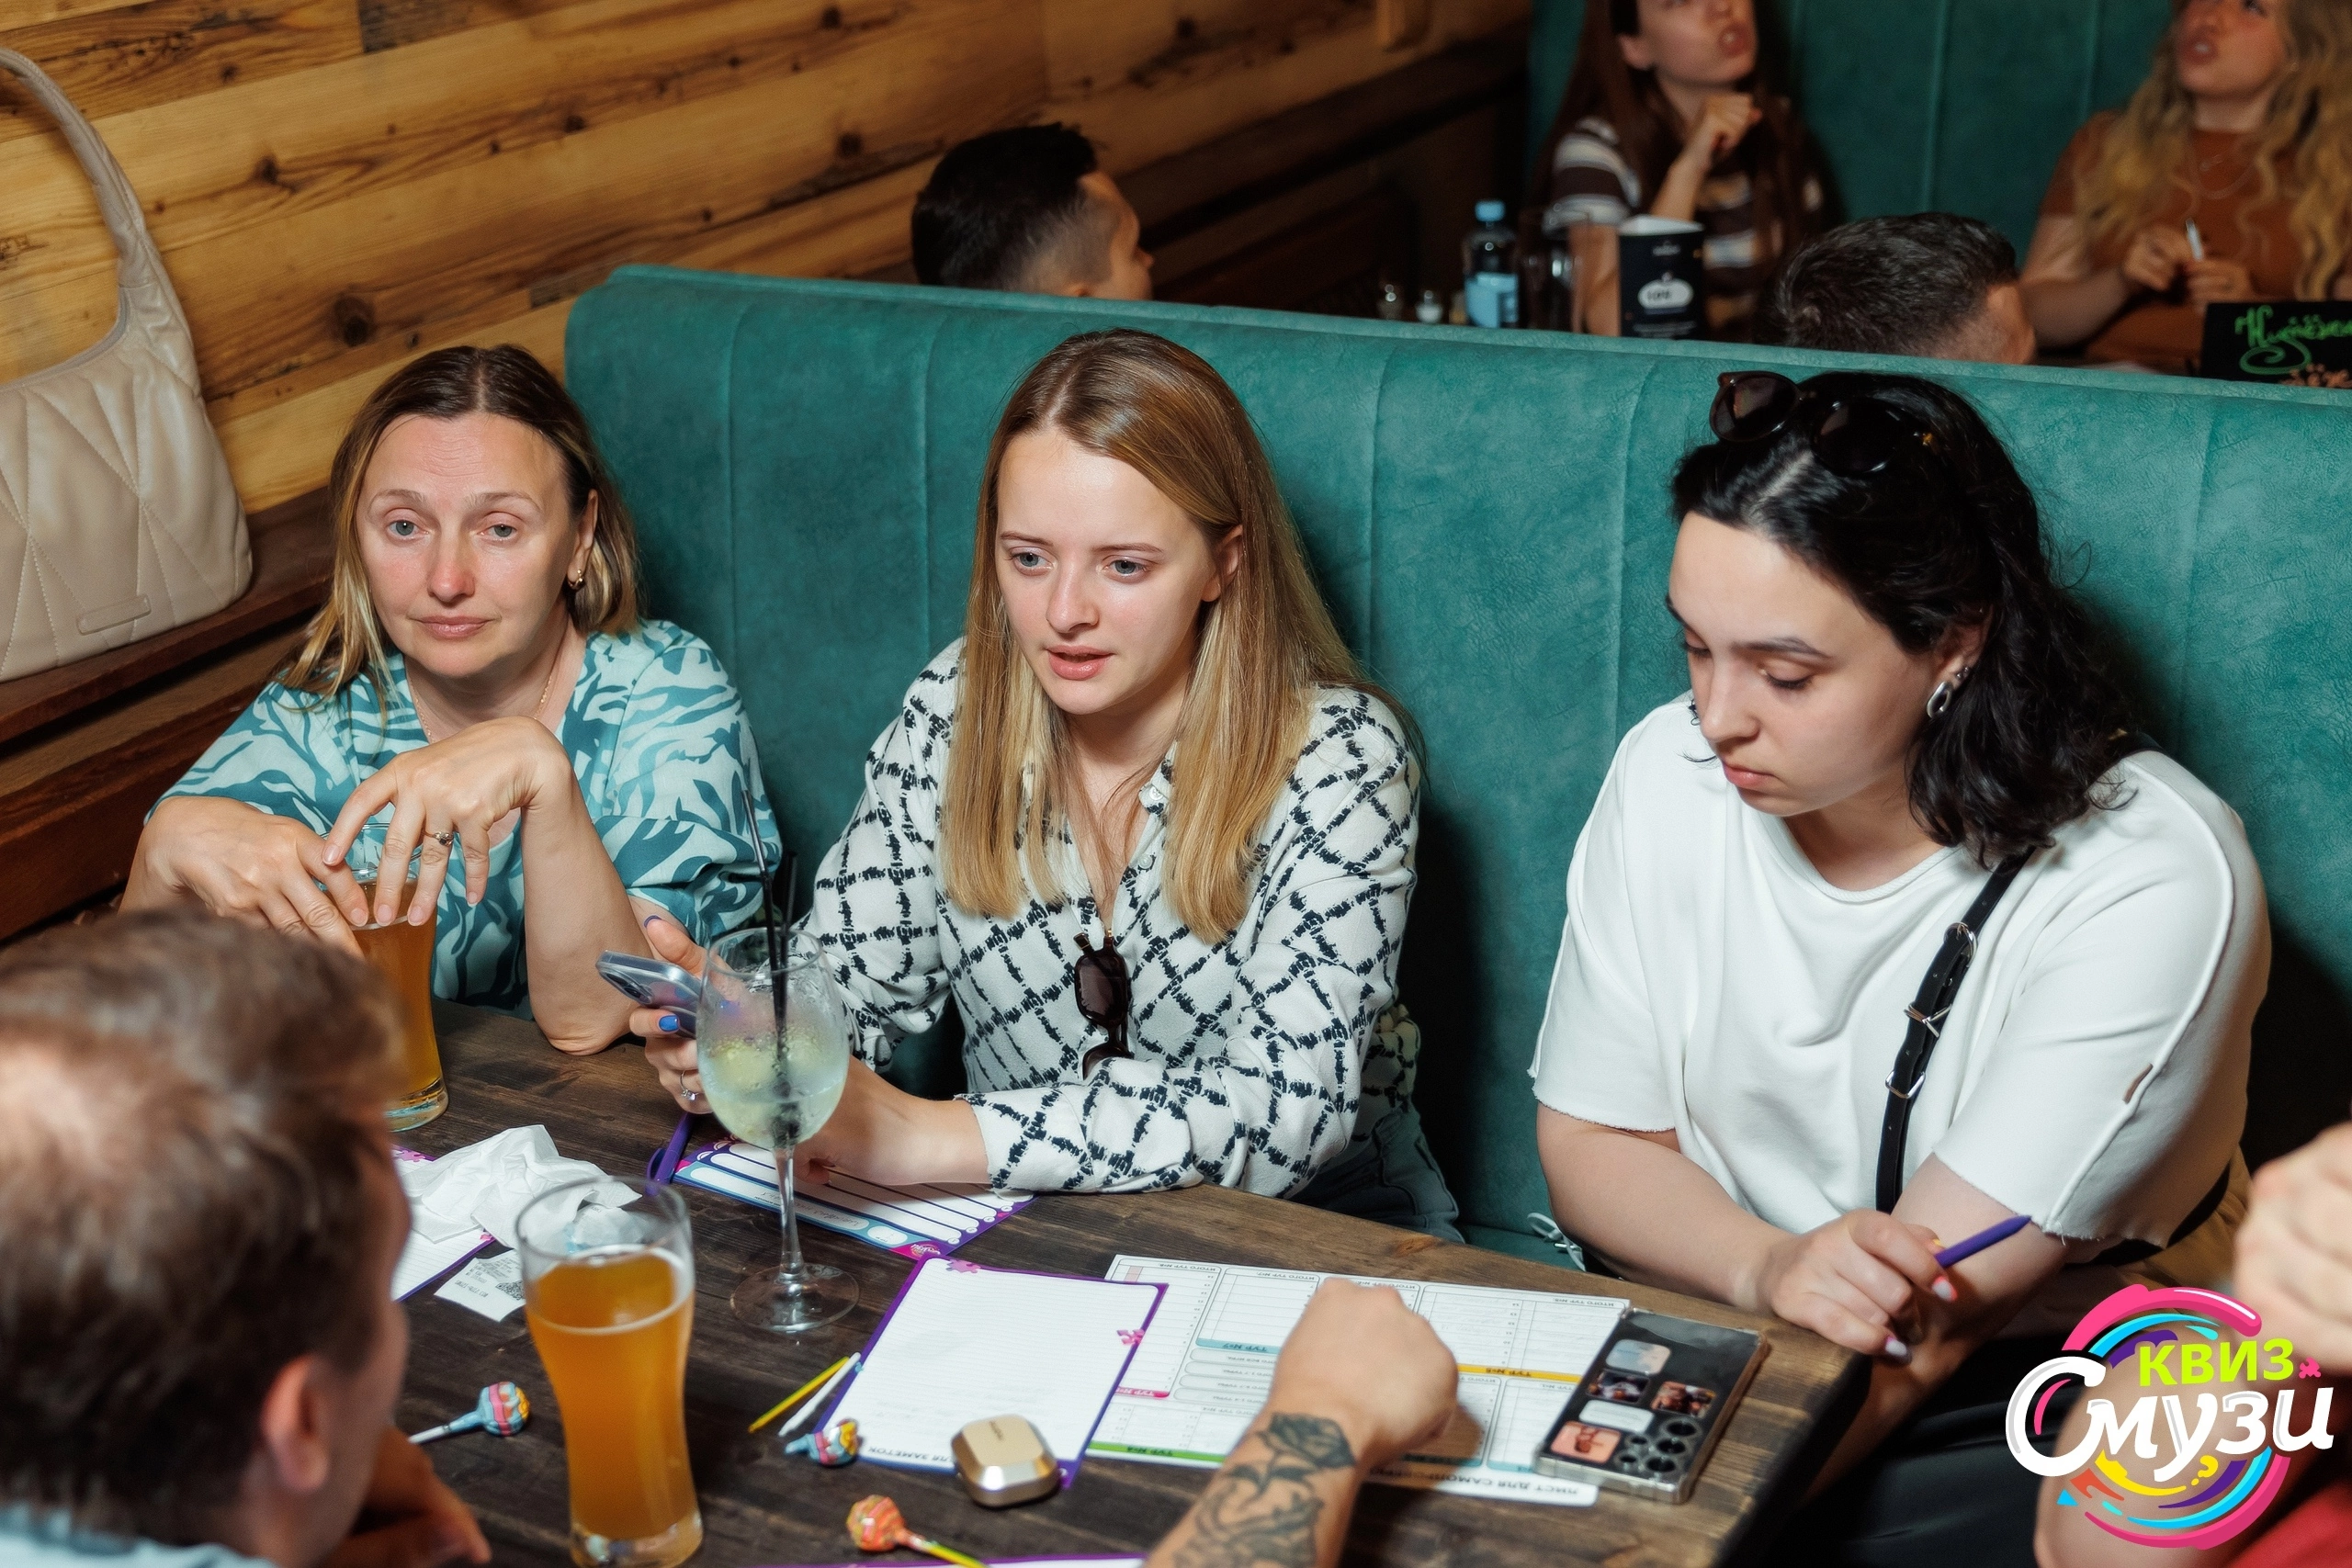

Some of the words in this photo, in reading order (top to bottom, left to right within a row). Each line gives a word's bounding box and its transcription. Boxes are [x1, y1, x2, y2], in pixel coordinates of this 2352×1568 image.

[868, 1447, 928, 1460] ЗАМЕТОК
[1497, 1481, 1532, 1490] ДЛЯ
[1536, 1484, 1577, 1495] ЛИСТ
